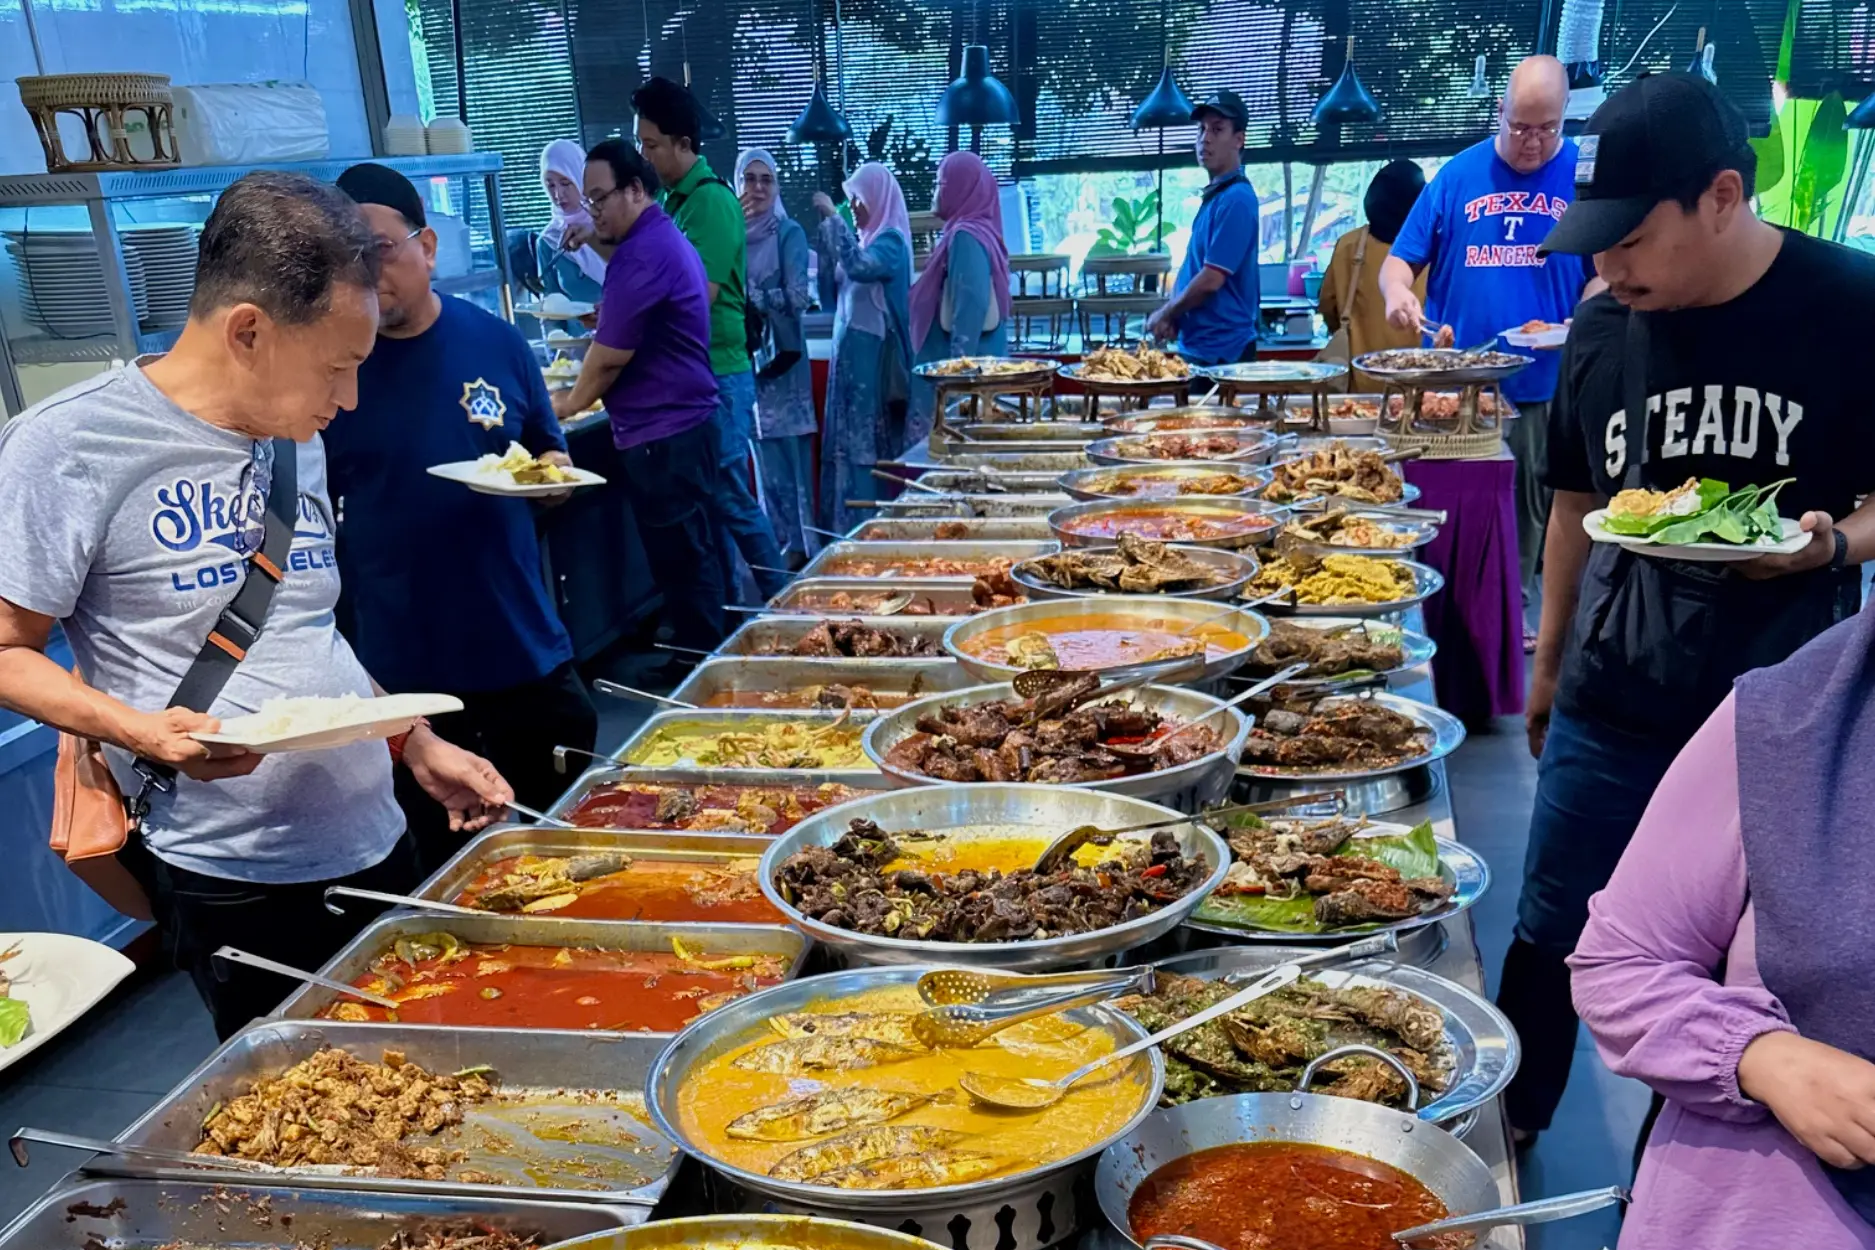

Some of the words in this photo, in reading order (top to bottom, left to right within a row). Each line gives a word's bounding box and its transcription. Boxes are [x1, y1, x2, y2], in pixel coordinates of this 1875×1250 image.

[1465, 191, 1568, 222] TEXAS
[1503, 216, 1524, 241] T
[171, 562, 238, 592] LOS
